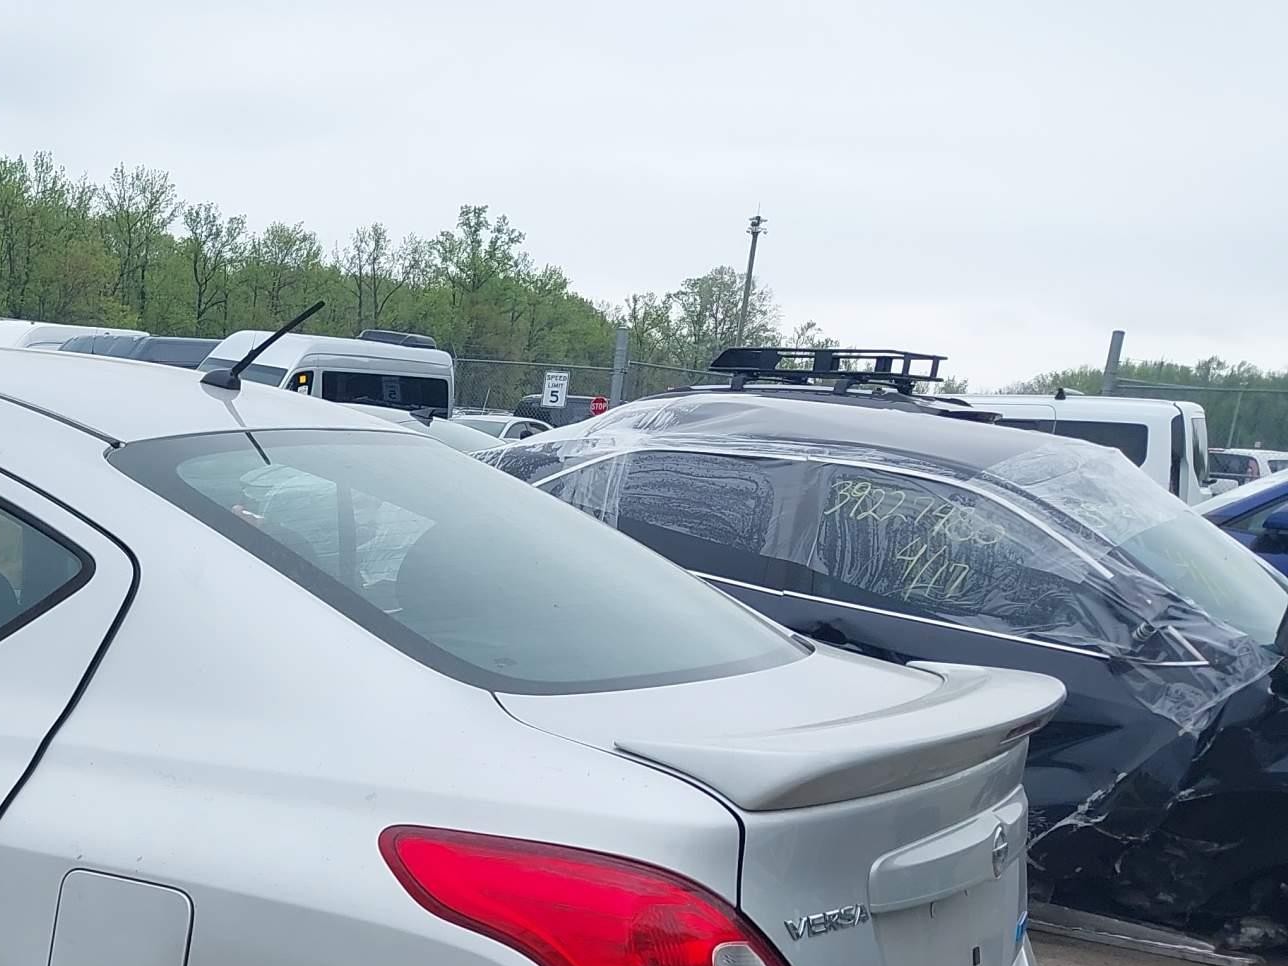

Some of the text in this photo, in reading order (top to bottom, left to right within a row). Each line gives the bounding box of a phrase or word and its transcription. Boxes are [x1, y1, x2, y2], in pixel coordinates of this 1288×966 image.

[549, 390, 560, 403] 5
[592, 402, 607, 411] STOP
[896, 536, 970, 600] 4/17
[783, 904, 871, 942] VERSA
